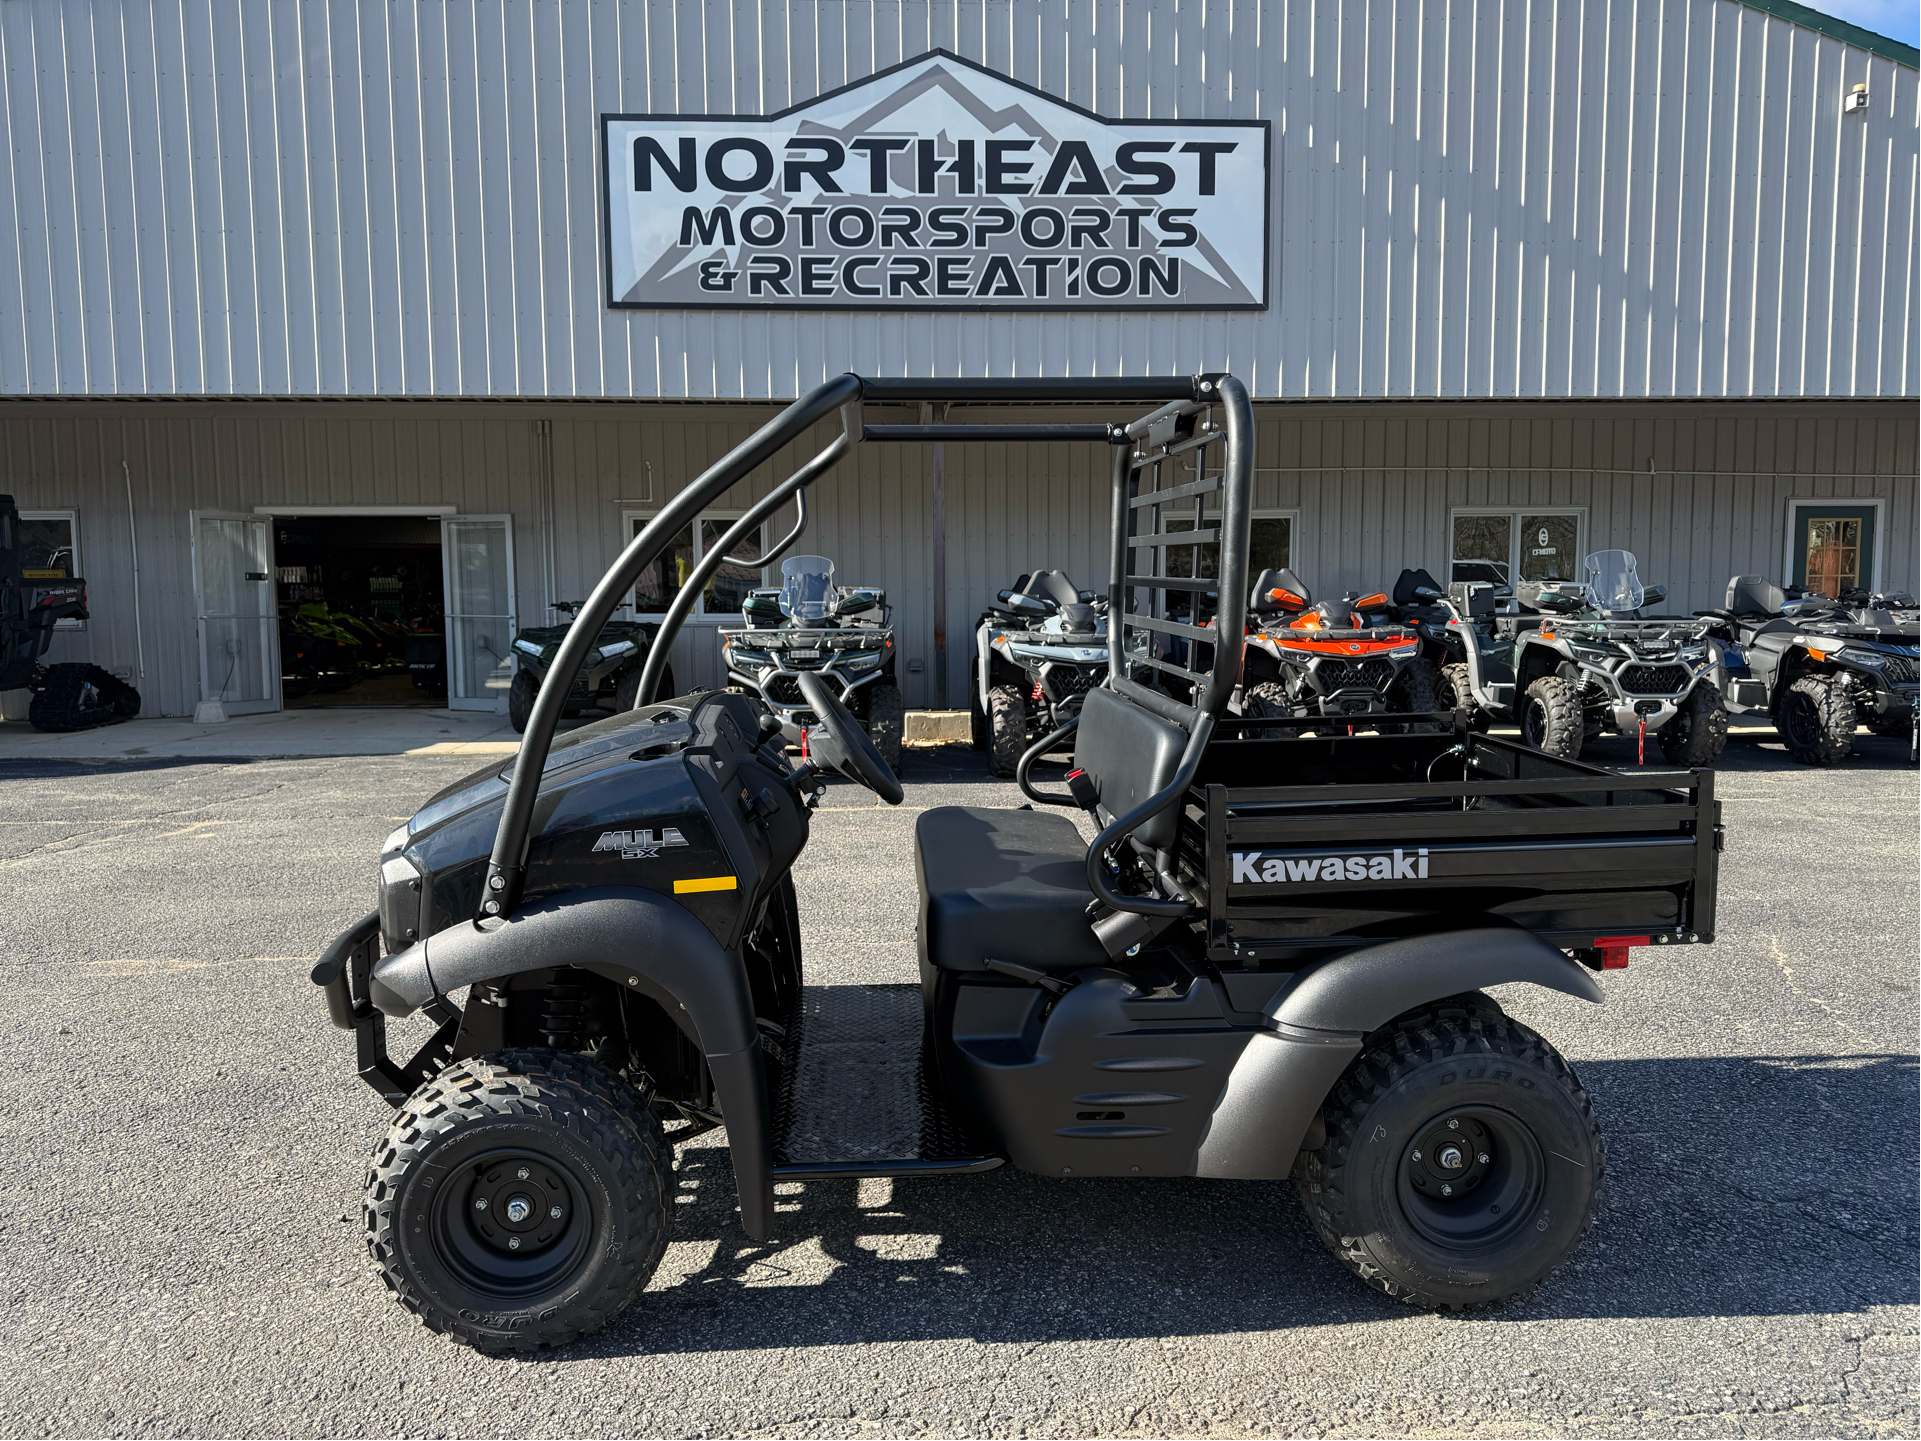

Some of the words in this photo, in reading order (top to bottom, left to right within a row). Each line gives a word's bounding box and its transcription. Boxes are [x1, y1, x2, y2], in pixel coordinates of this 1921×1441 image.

[632, 135, 1239, 196] NORTHEAST
[678, 204, 1199, 249] MOTORSPORTS
[748, 255, 1181, 298] RECREATION
[592, 827, 690, 852] MULE
[621, 847, 660, 860] SX
[1232, 847, 1429, 884] Kawasaki
[1438, 1066, 1538, 1091] DURO
[458, 1305, 560, 1330] DURO
